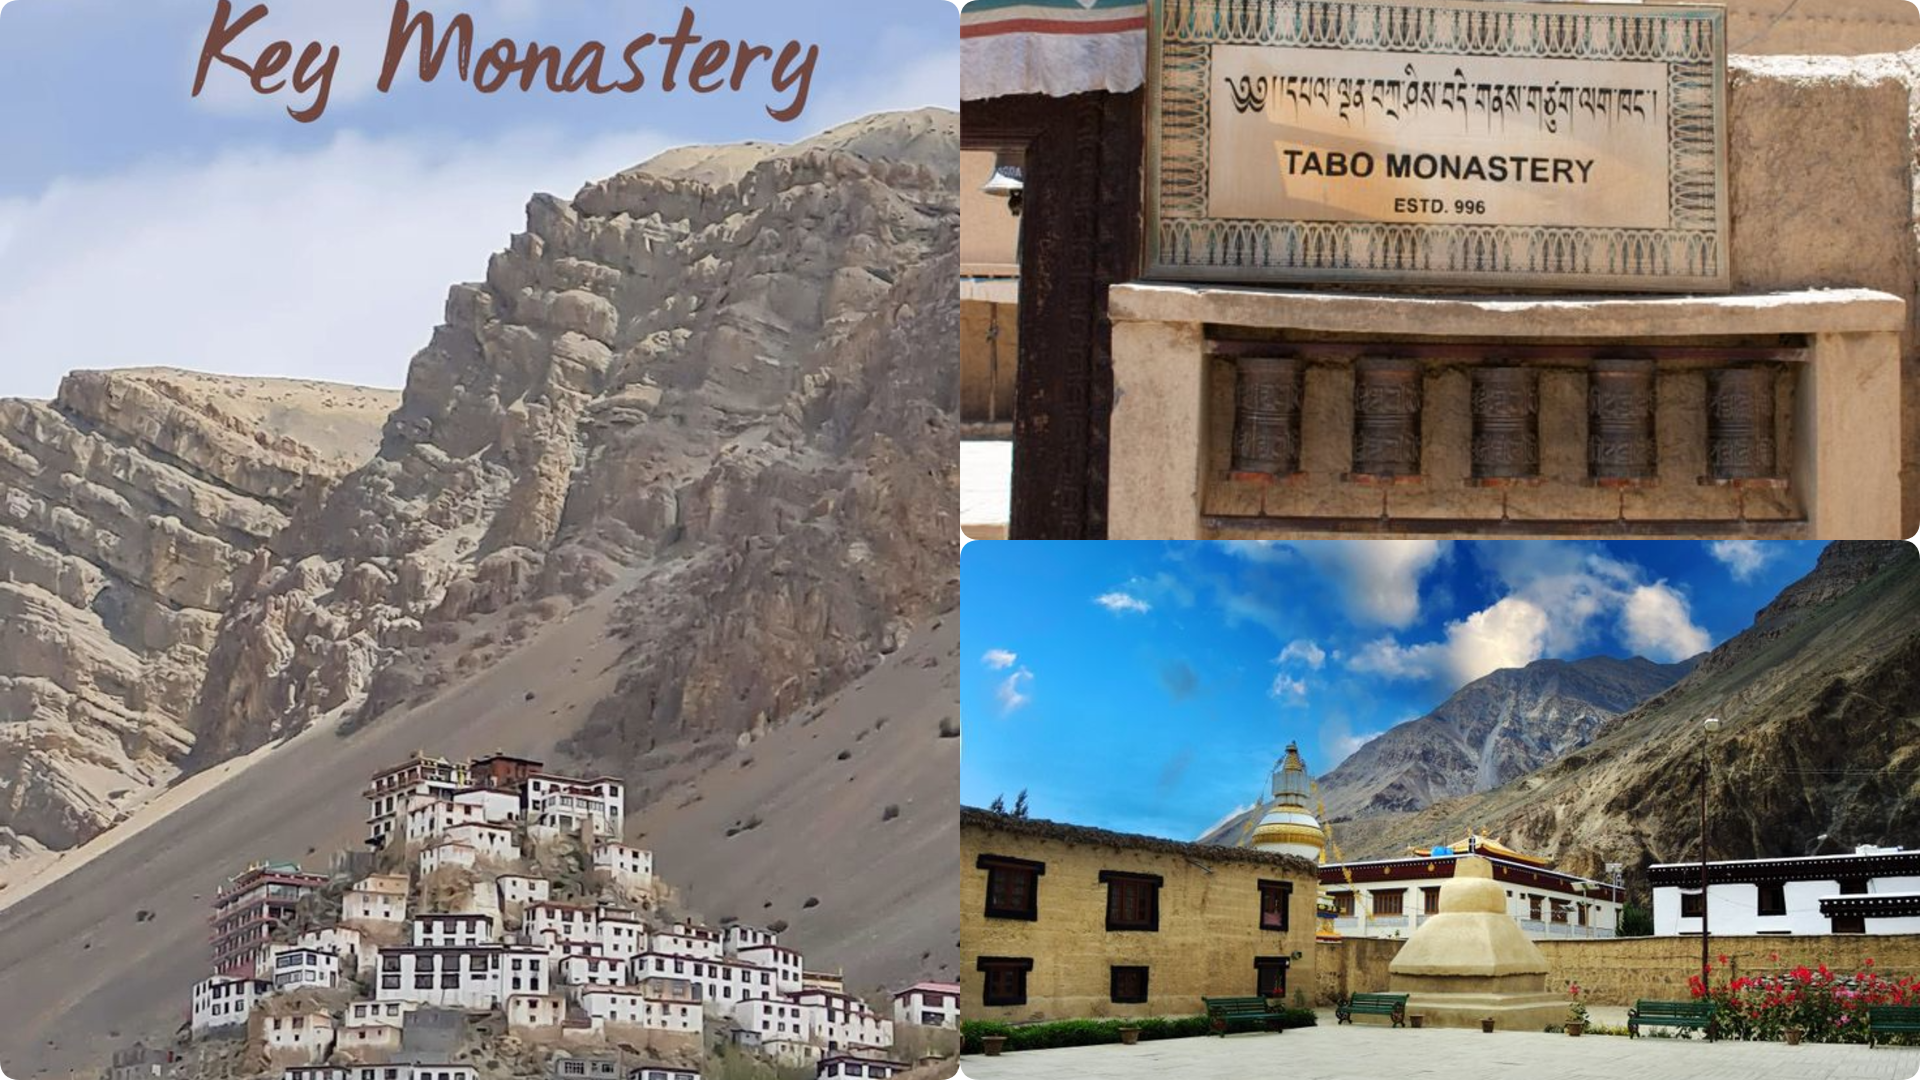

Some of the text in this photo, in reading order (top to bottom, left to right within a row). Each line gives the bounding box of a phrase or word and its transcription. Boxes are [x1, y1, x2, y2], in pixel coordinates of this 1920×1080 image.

[1283, 149, 1595, 184] TABO MONASTERY
[1393, 197, 1486, 215] ESTD. 996
